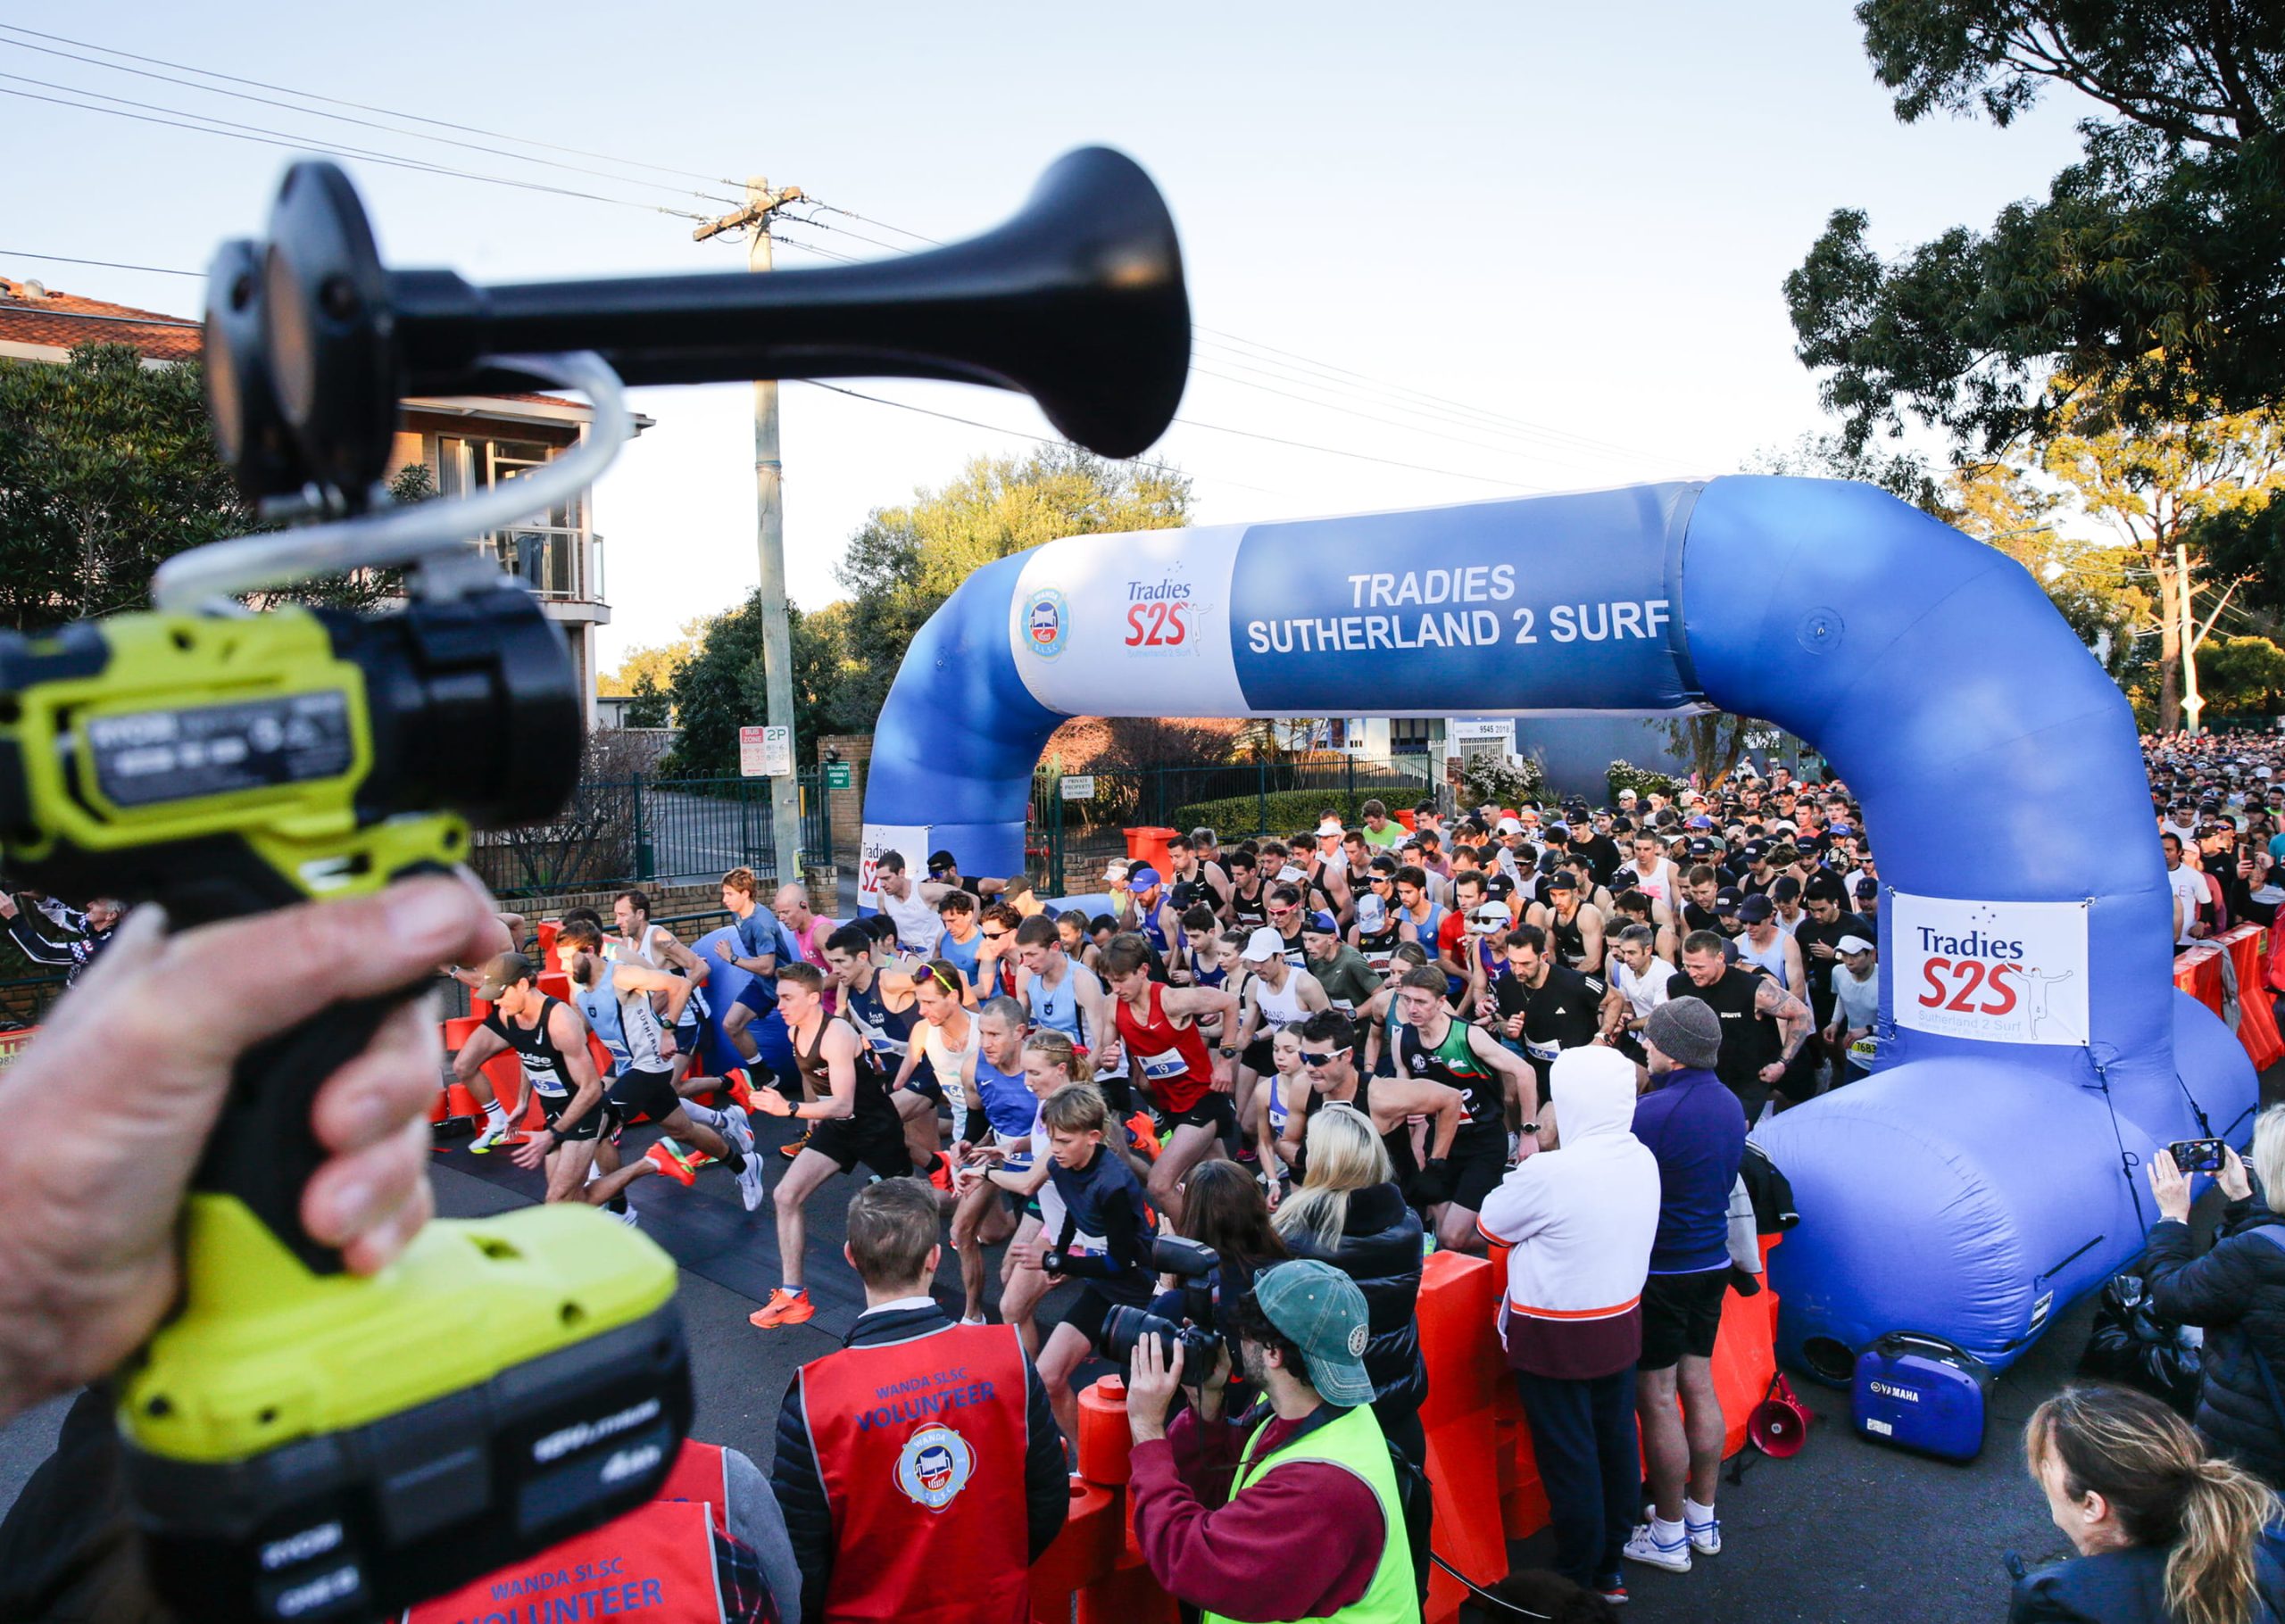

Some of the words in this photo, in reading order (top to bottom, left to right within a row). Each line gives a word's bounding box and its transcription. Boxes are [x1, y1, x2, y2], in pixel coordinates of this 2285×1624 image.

[1128, 578, 1191, 601] Tradies
[1348, 564, 1516, 608] TRADIES
[1125, 601, 1189, 646] S2S
[1248, 609, 1500, 653] SUTHERLAND
[1512, 608, 1538, 644] 2
[1550, 600, 1670, 642] SURF
[768, 729, 785, 741] 2P
[1496, 725, 1510, 733] 2018
[1917, 926, 2023, 959] Tradies
[1918, 957, 2023, 1015] S2S
[1919, 1010, 1978, 1029] Sutherland
[1982, 1019, 1990, 1029] 2
[1993, 1020, 2023, 1032] Surf
[1156, 1064, 1169, 1074] 19
[876, 1375, 930, 1400] WANDA
[933, 1366, 968, 1386] SLSC
[1881, 1383, 1919, 1402] YAMAHA
[854, 1381, 995, 1433] VOLUNTEER
[913, 1433, 946, 1448] WANDA
[492, 1570, 570, 1602] WANDA
[574, 1556, 624, 1583] SLSC
[456, 1578, 663, 1624] UNTEER
